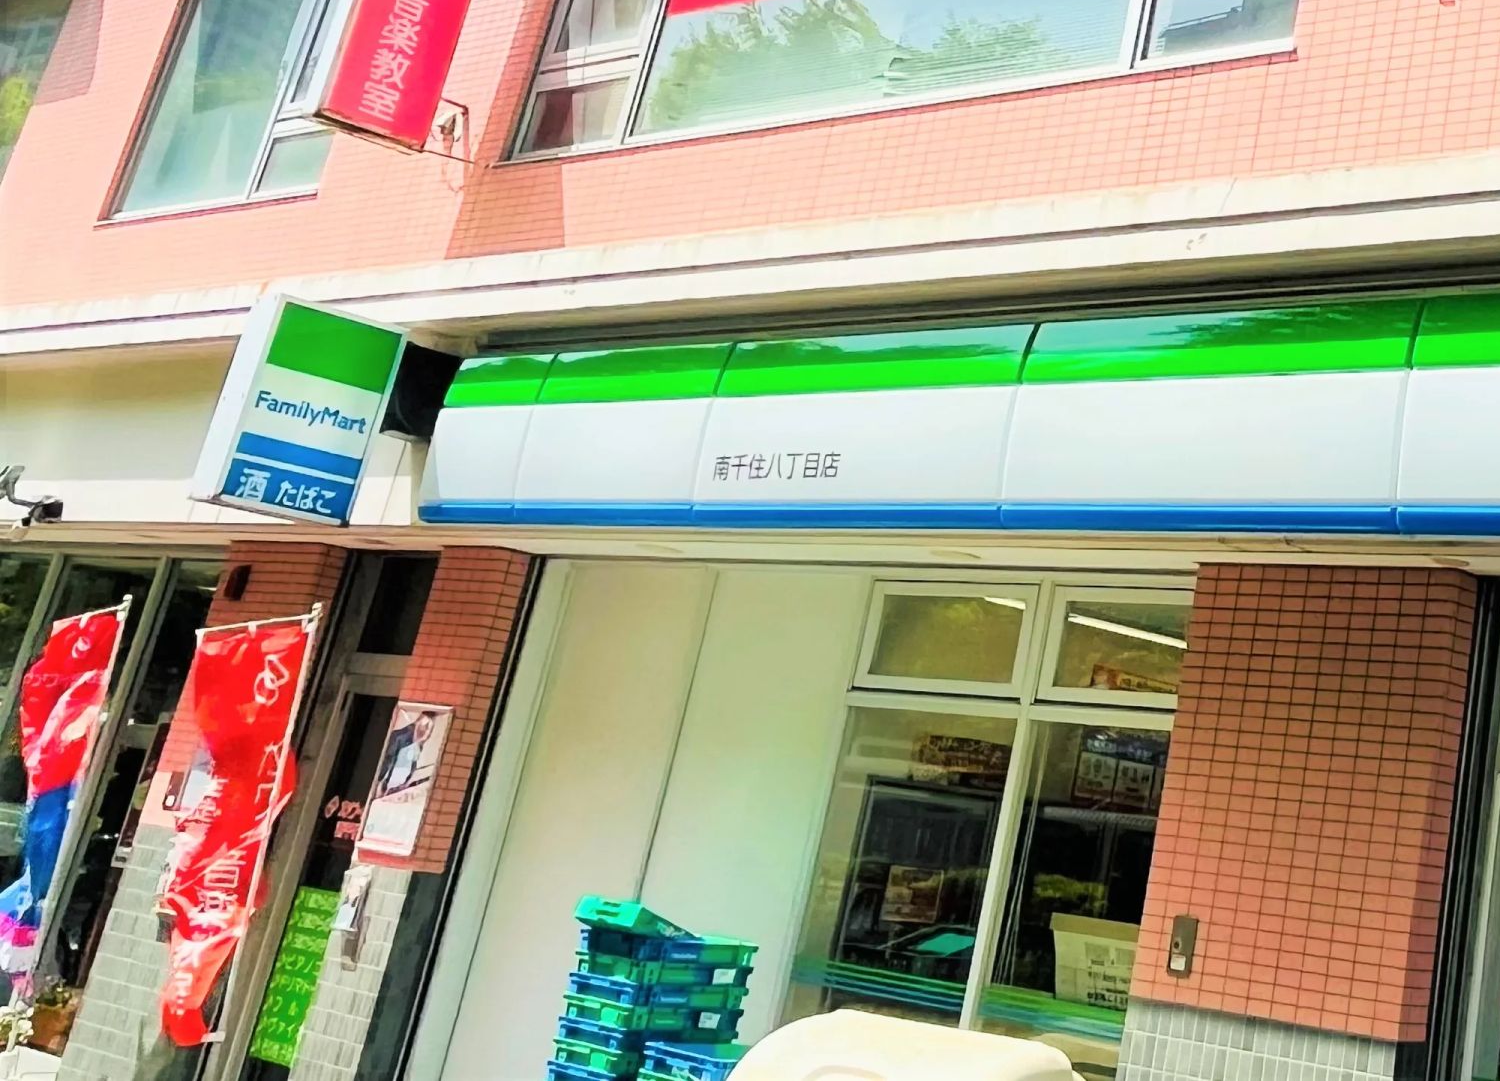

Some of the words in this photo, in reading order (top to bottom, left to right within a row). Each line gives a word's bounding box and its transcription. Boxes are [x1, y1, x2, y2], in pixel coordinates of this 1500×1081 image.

[255, 390, 366, 434] FamilyMart
[712, 451, 841, 481] 南千住八丁目店
[235, 467, 271, 503] 酒
[274, 480, 337, 514] たばこ
